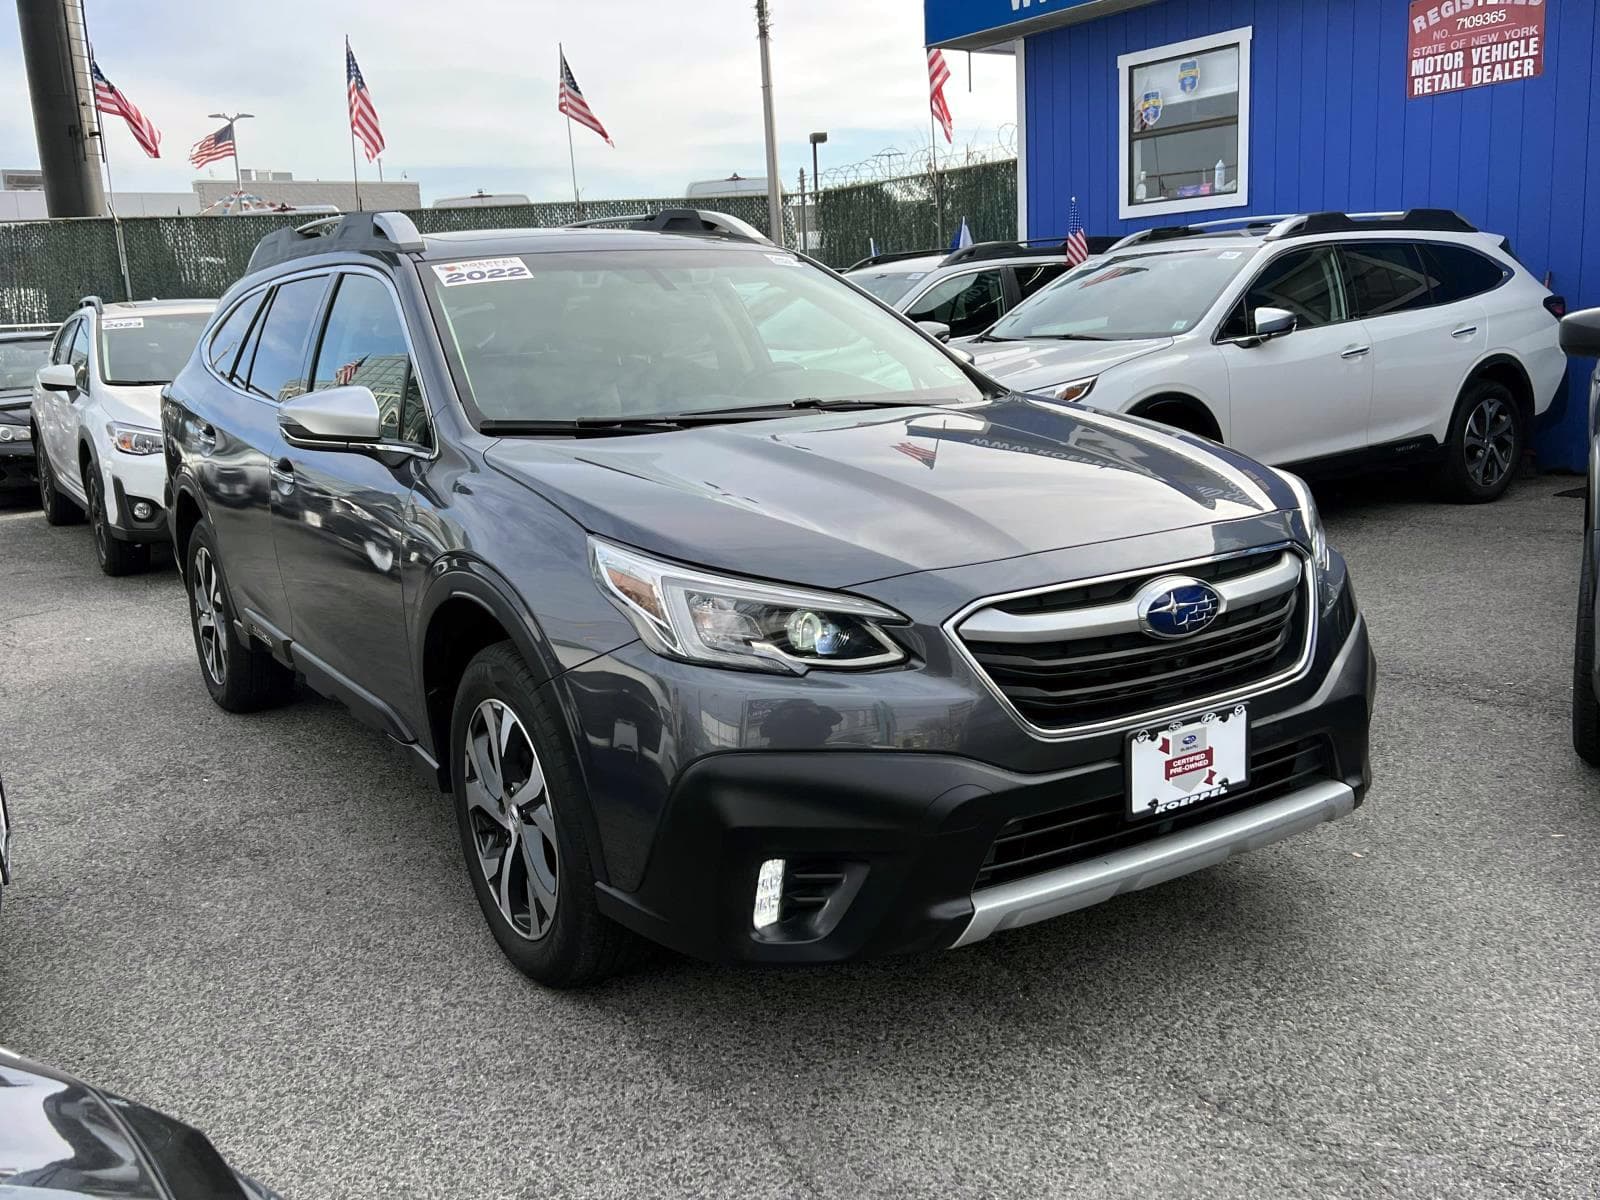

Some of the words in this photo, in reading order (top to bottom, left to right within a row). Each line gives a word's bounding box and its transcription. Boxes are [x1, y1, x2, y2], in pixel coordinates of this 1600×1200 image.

[1432, 28, 1451, 41] NO.
[1456, 9, 1506, 30] 7109365
[1412, 44, 1446, 57] STATE
[1450, 38, 1467, 50] OF
[1471, 32, 1499, 45] NEW
[1504, 24, 1538, 41] YORK
[1411, 50, 1464, 77] MOTOR
[1471, 37, 1539, 66] VEHICLE
[1413, 70, 1466, 96] RETAIL
[1471, 58, 1534, 86] DEALER
[445, 267, 527, 284] 2022
[1169, 759, 1208, 775] PRE-OWNED
[1173, 753, 1205, 767] CERTIFIED
[1154, 787, 1228, 814] KOEPPEL
